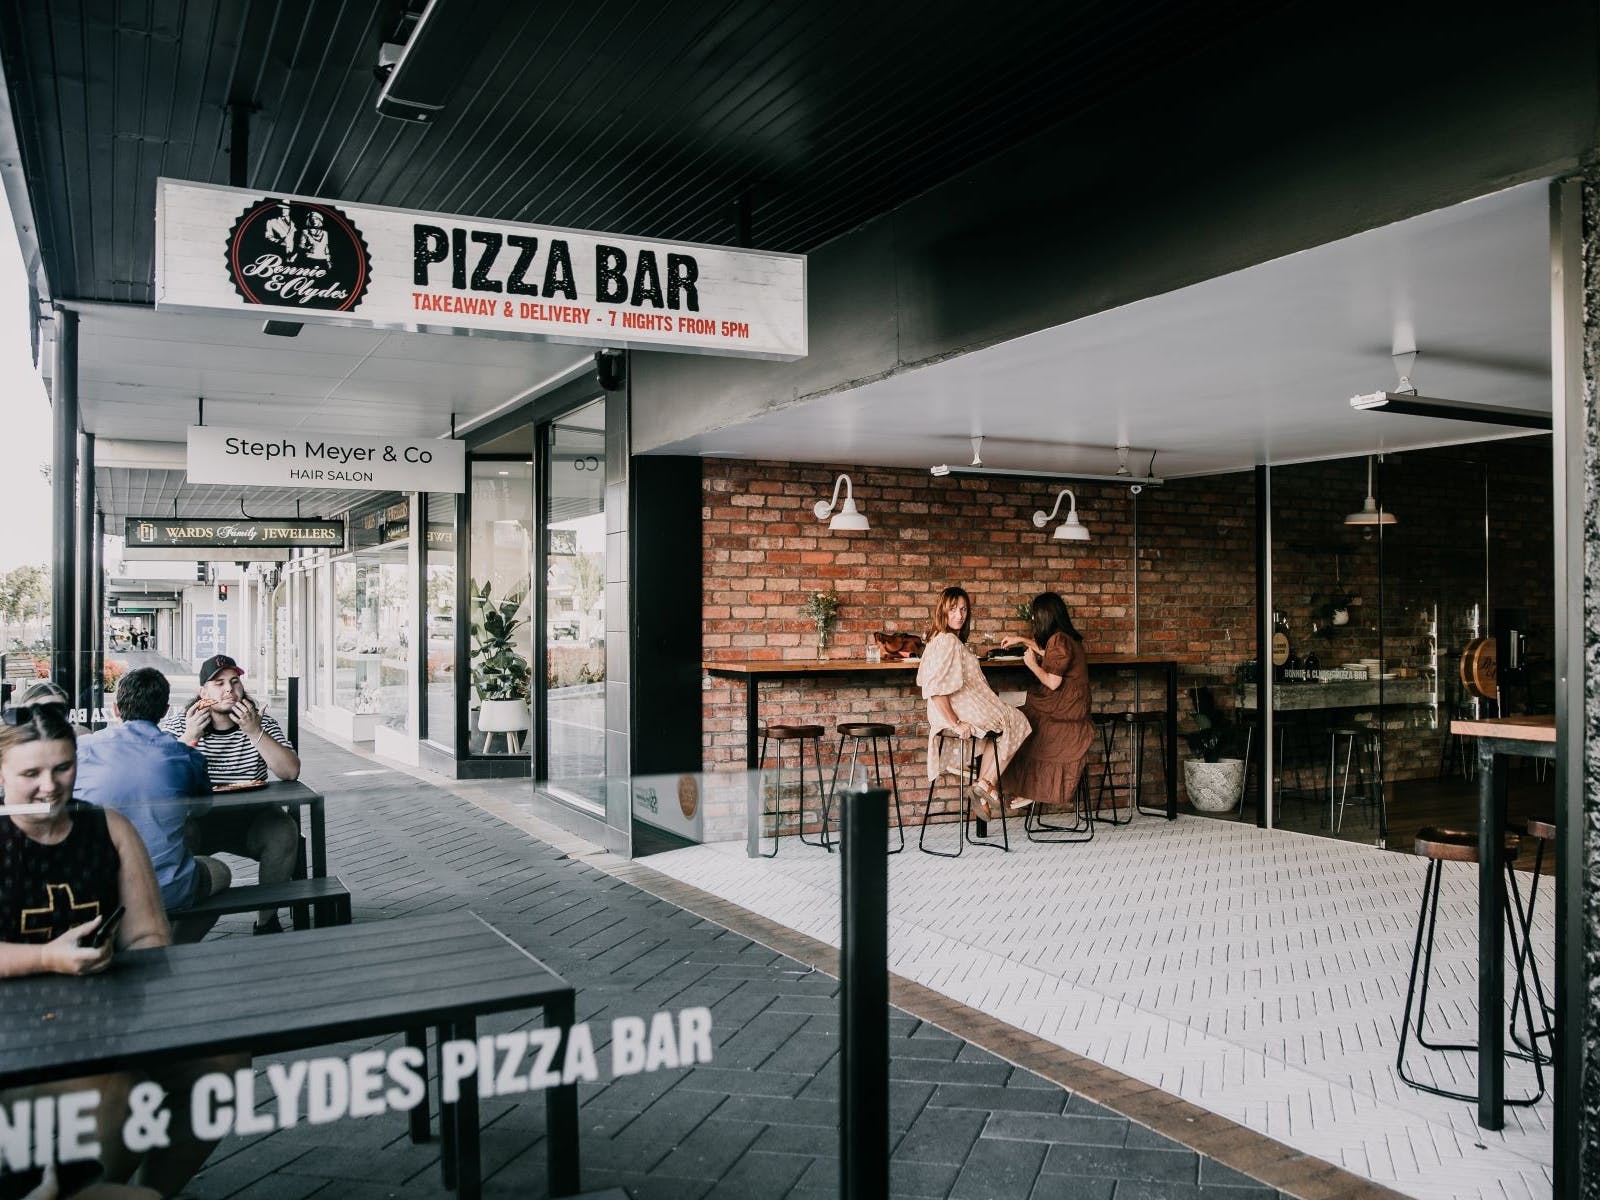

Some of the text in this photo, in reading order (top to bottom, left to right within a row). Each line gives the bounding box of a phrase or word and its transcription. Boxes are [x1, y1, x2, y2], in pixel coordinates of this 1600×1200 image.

[242, 254, 327, 278] Bonnie
[413, 223, 700, 312] PIZZA BAR
[264, 275, 348, 304] & Clydes
[412, 292, 497, 316] TAKEAWAY
[503, 301, 514, 318] &
[520, 302, 590, 325] DELIVERY
[608, 310, 617, 327] 7
[623, 312, 673, 332] NIGHTS
[678, 317, 716, 335] FROM
[721, 321, 749, 338] 5PM
[225, 437, 433, 464] Steph Meyer & Co
[290, 469, 373, 482] HAIR SALON
[165, 527, 214, 538] WARDS
[216, 524, 258, 540] Family
[262, 528, 336, 540] JEWELLERS
[197, 634, 225, 643] LEAE
[122, 1080, 171, 1153] &
[190, 1045, 426, 1142] CLYDES
[441, 1022, 598, 1104] PIZZA
[612, 1006, 714, 1078] BAR
